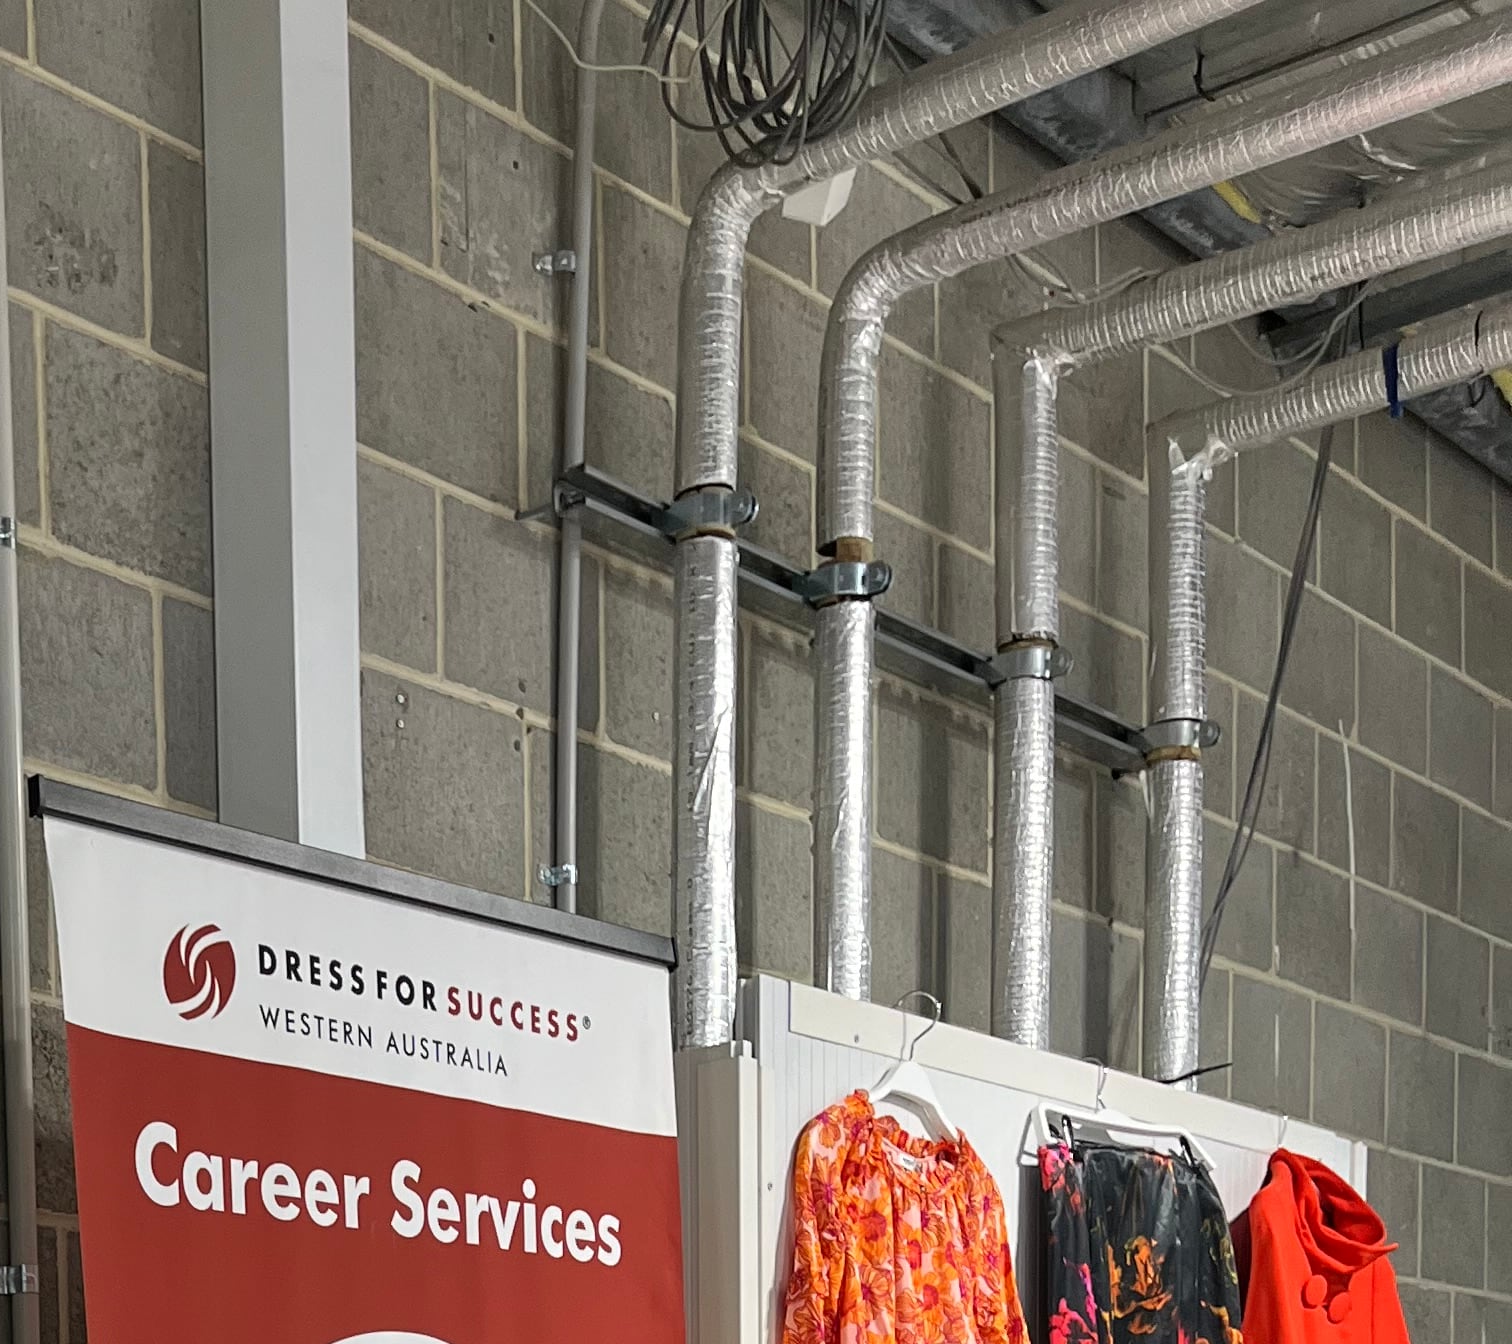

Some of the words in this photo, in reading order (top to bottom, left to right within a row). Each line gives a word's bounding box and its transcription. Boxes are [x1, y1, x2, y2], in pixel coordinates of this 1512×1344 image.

[258, 1003, 373, 1049] WESTERN
[385, 1030, 508, 1077] AUSTRALIA
[134, 1121, 370, 1229] Career
[390, 1159, 622, 1267] Services
